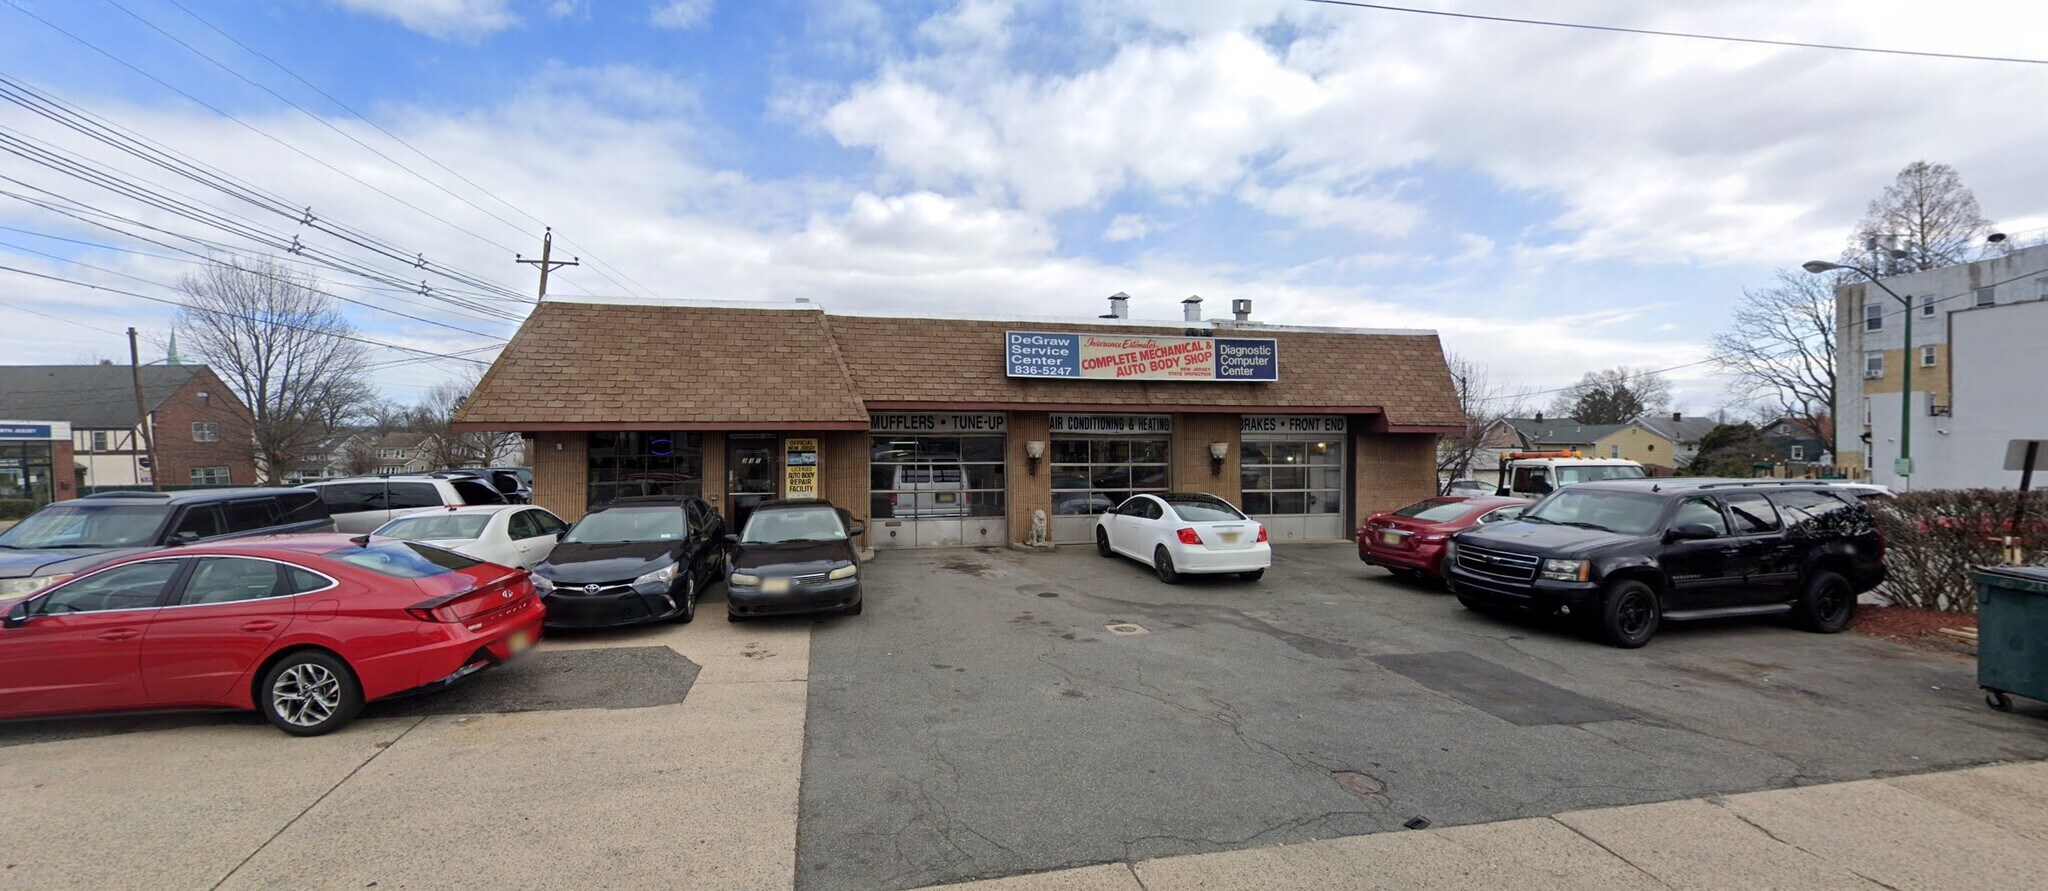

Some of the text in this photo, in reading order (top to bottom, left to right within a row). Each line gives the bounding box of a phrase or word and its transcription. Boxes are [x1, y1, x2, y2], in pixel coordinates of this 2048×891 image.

[1011, 335, 1070, 346] DeGraw
[1011, 345, 1069, 356] Service
[1081, 341, 1212, 370] COMPLETE MECHANICAL &
[1220, 344, 1271, 356] Diagnostic
[1011, 355, 1062, 365] Center
[1116, 351, 1212, 377] AUTO BODY SHOP
[1220, 355, 1268, 367] Computer
[1015, 365, 1071, 375] 836-5247
[1221, 366, 1254, 376] Center
[871, 415, 1004, 430] MUFFLERS TUNE-UP
[1050, 416, 1169, 431] AIR CONDITIONING & HEATING
[1240, 417, 1344, 431] BRAKES FRONT END
